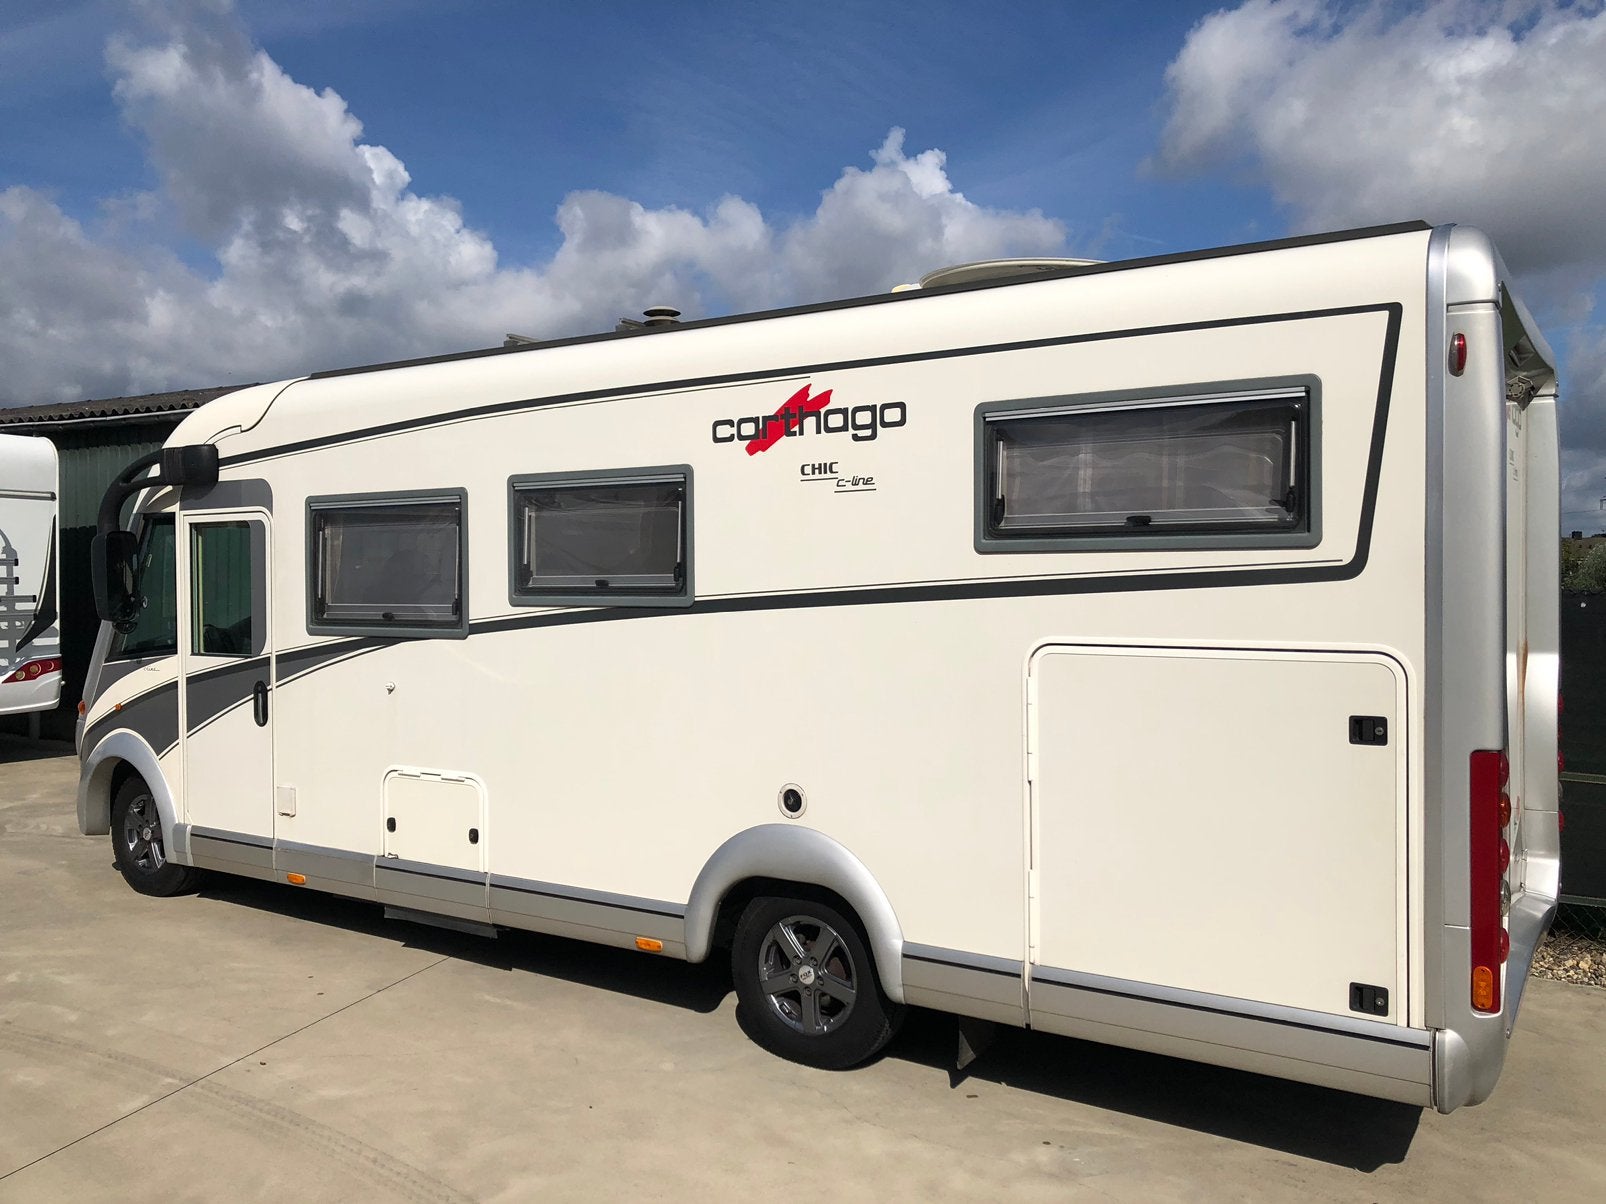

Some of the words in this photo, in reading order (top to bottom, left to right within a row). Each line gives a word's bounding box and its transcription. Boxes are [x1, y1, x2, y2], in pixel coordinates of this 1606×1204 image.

[712, 401, 907, 443] carthago
[800, 461, 839, 476] CHIC
[836, 475, 876, 487] c-line
